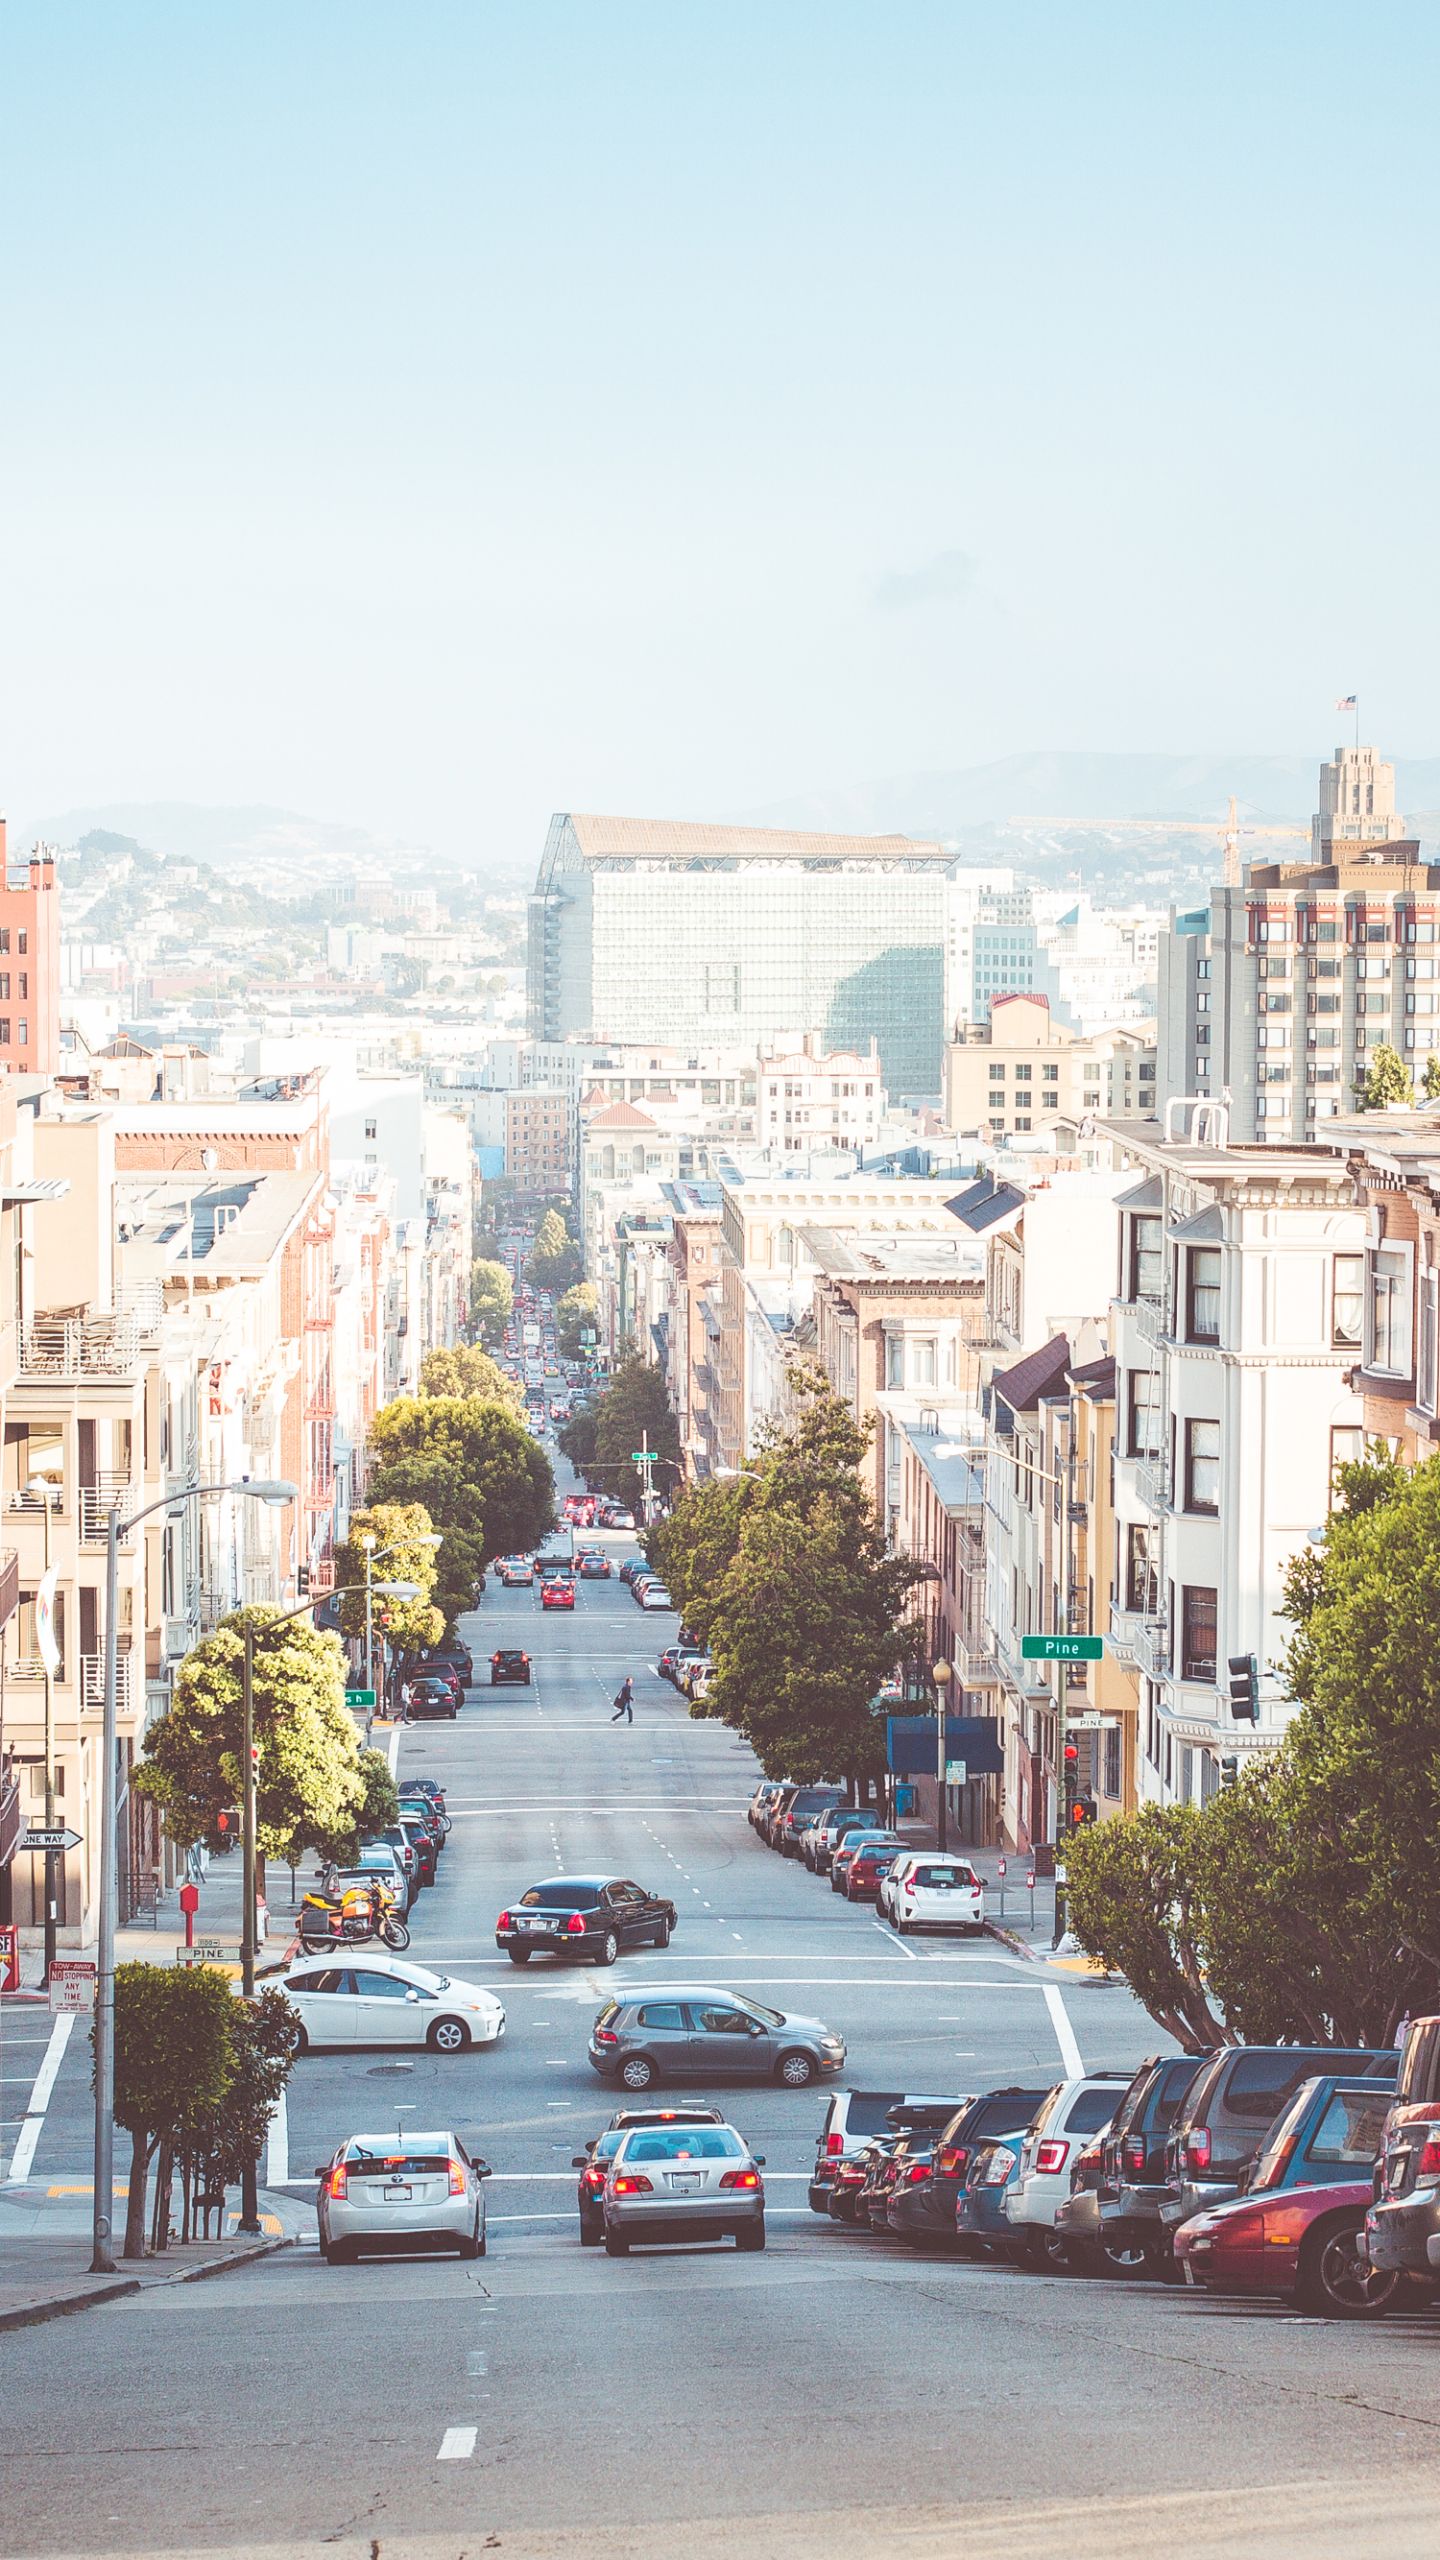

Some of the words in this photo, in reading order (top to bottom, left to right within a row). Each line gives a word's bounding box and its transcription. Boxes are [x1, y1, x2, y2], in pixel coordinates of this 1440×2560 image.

[1045, 1641, 1080, 1654] Pine
[1079, 1719, 1104, 1727] PINE
[44, 1835, 63, 1844] WAY
[193, 1949, 225, 1958] PINE
[51, 1970, 63, 1980] NO
[65, 1982, 80, 1991] ANY
[64, 1992, 81, 2001] TIME
